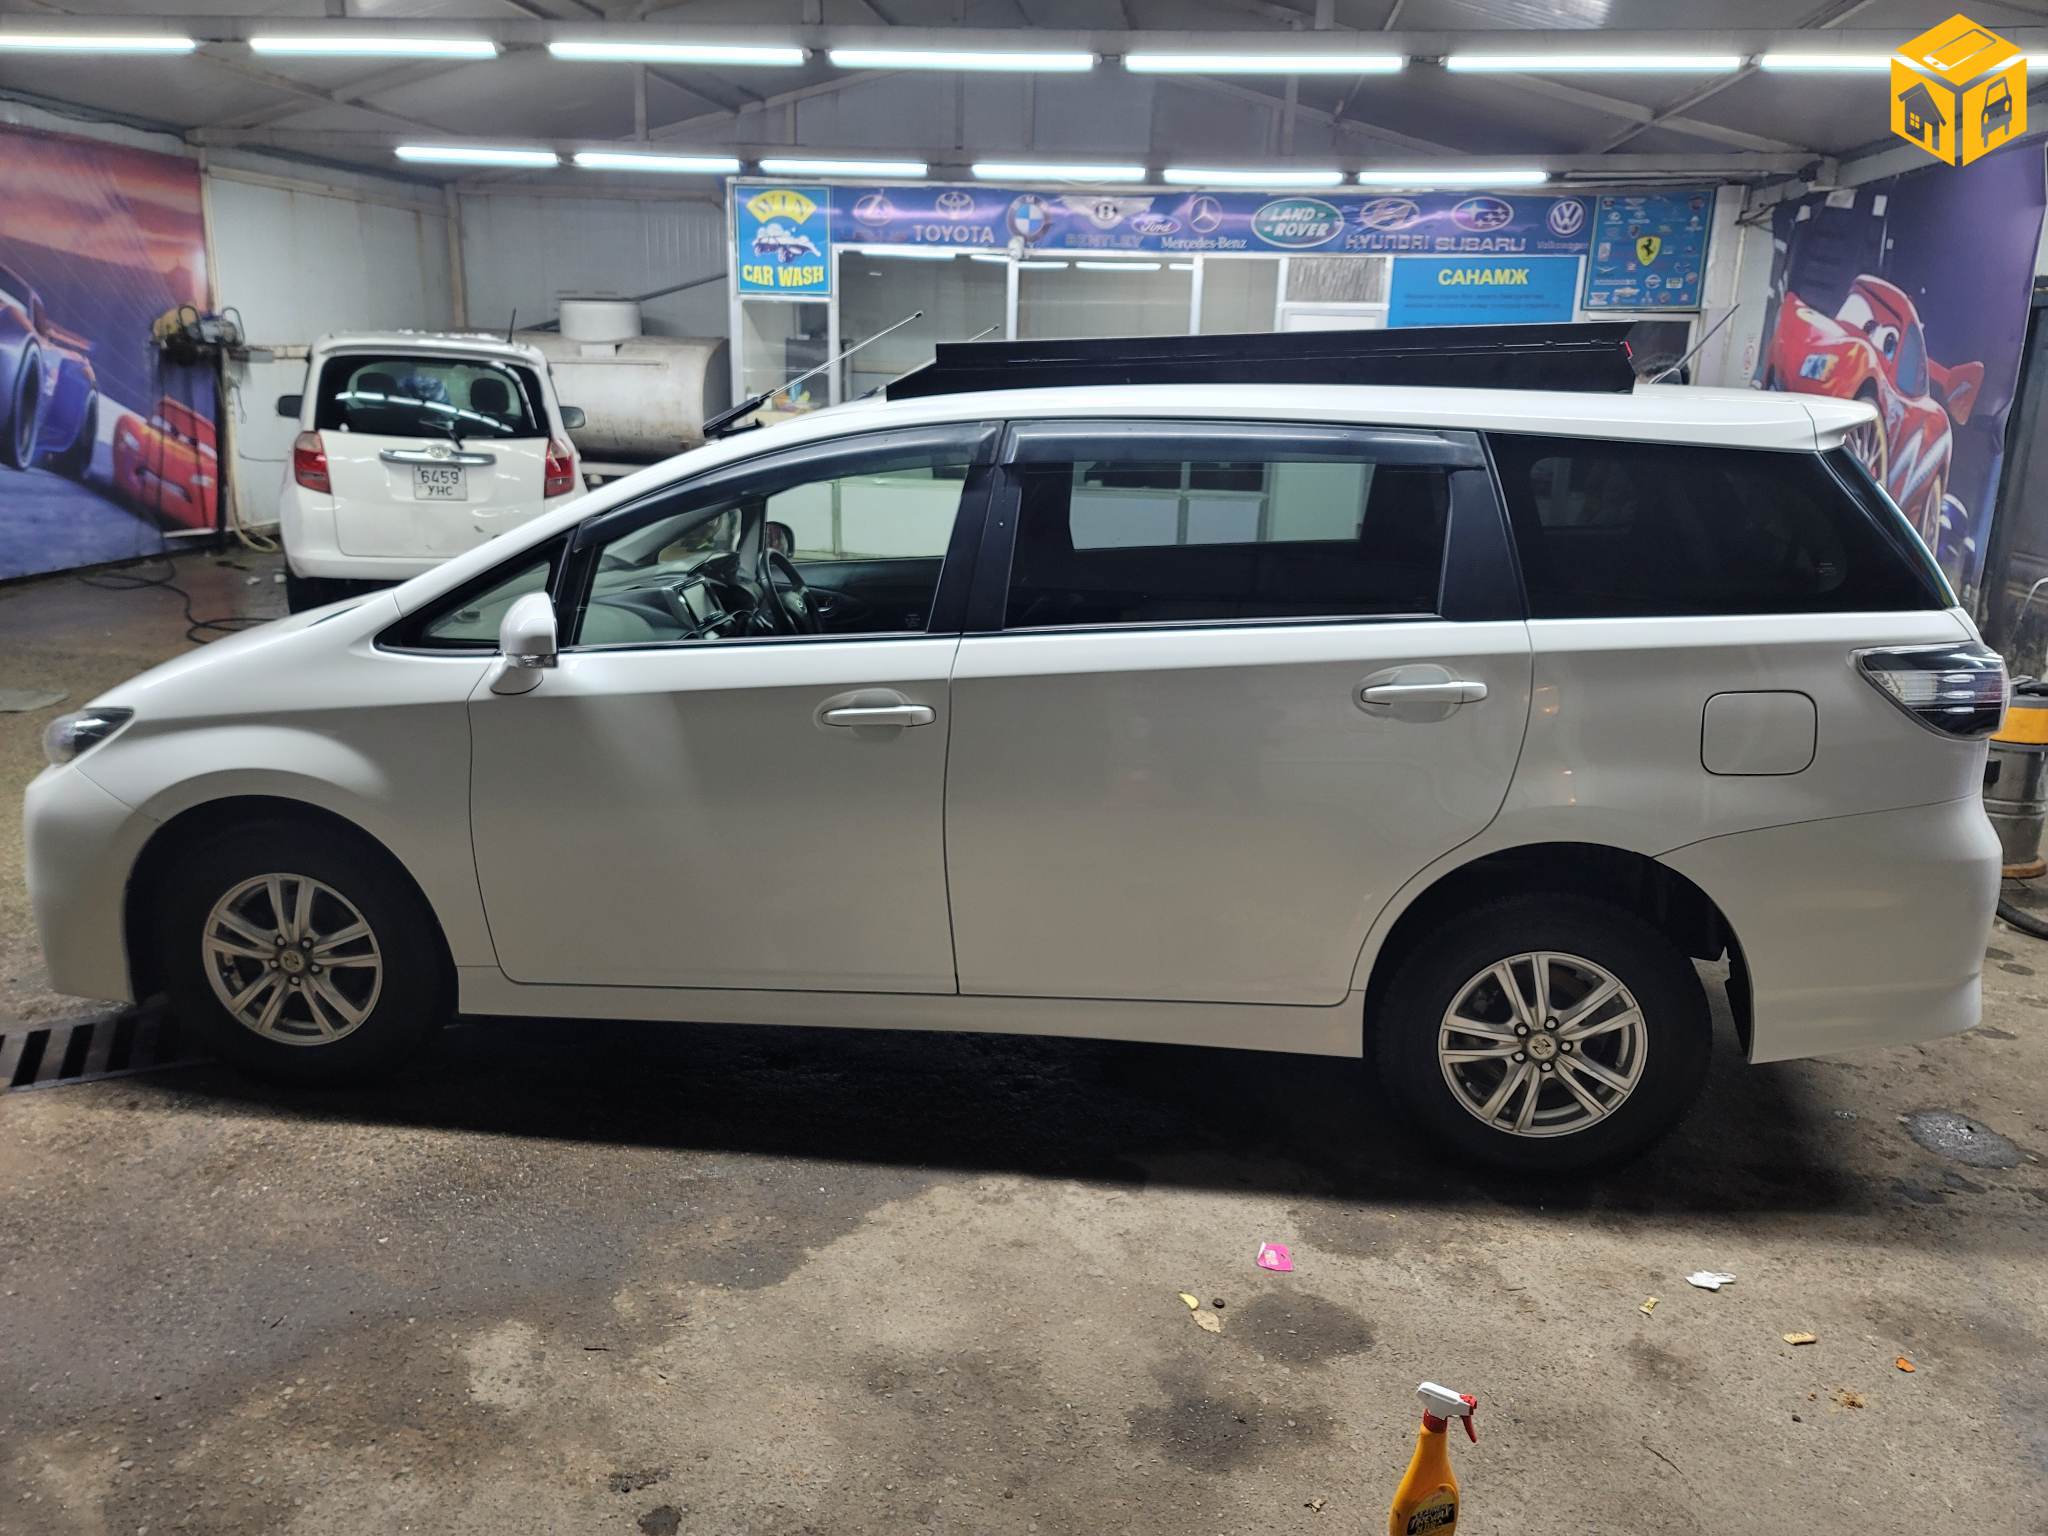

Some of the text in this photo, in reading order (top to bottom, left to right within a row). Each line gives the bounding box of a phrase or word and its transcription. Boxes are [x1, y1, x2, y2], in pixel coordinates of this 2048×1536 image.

[1270, 207, 1317, 222] LAND
[1141, 218, 1174, 233] Ford
[1272, 222, 1331, 237] ROVER
[912, 224, 995, 244] TOYOTA
[1345, 233, 1430, 250] HYUNDAI
[1160, 236, 1248, 250] Mercedes-Benz
[1435, 236, 1527, 252] SUBARU
[742, 264, 825, 287] CAR WASH
[1437, 268, 1530, 286] САНАМЖ
[421, 470, 459, 484] 6459
[428, 485, 453, 496] УНС
